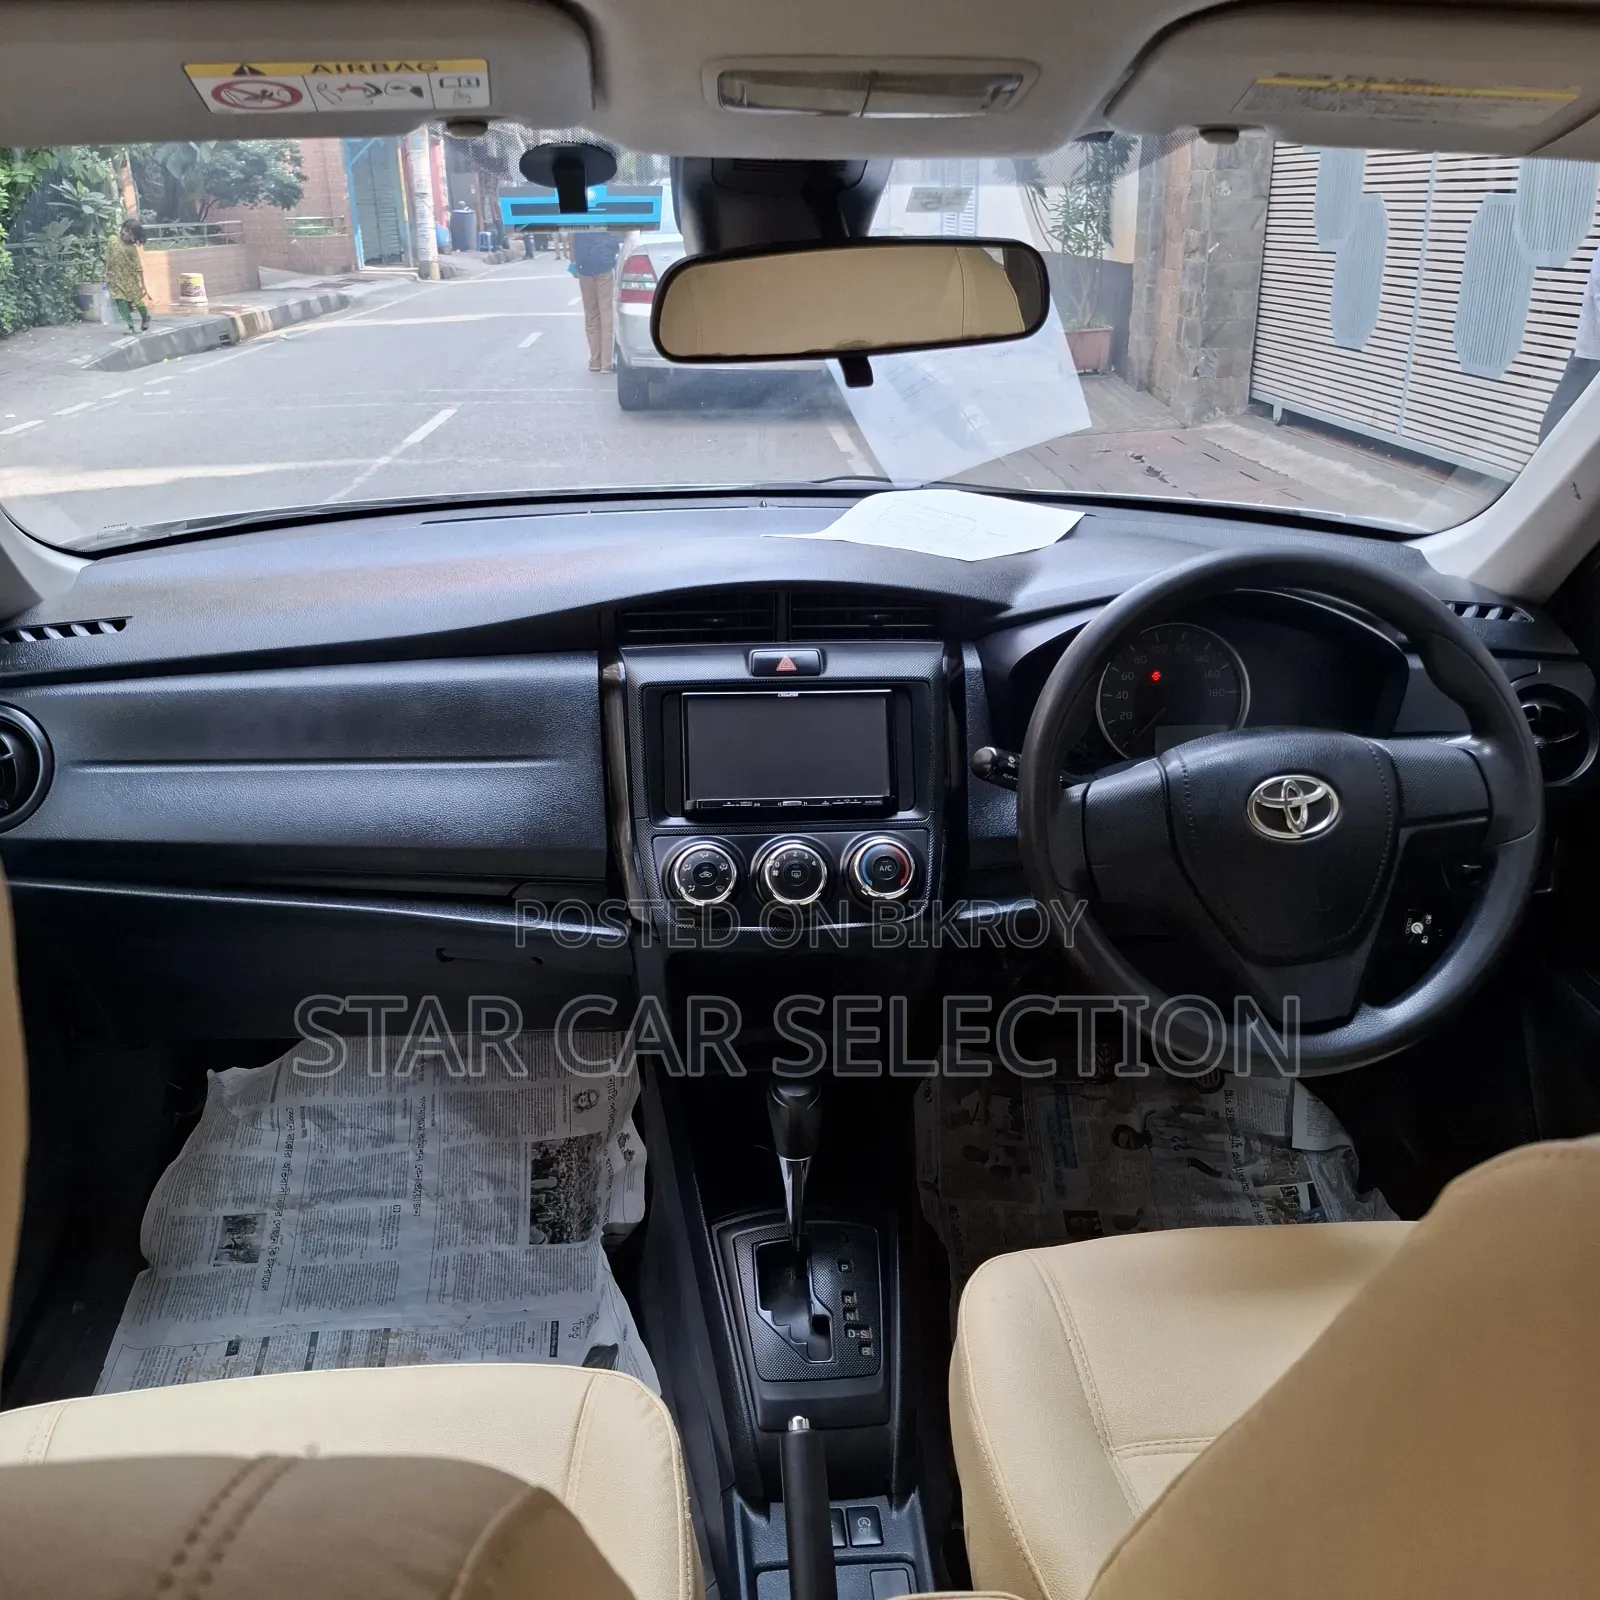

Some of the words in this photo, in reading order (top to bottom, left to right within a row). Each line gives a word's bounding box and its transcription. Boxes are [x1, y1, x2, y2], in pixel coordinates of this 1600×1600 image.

[312, 62, 439, 74] AIRBAG
[1121, 672, 1134, 680] 60
[1204, 670, 1219, 678] 160
[1116, 691, 1129, 699] 40
[1209, 688, 1225, 697] 180
[1120, 711, 1133, 720] 20
[841, 1264, 849, 1272] P
[844, 1295, 852, 1304] R
[846, 1312, 855, 1320] N
[862, 1347, 870, 1356] B
